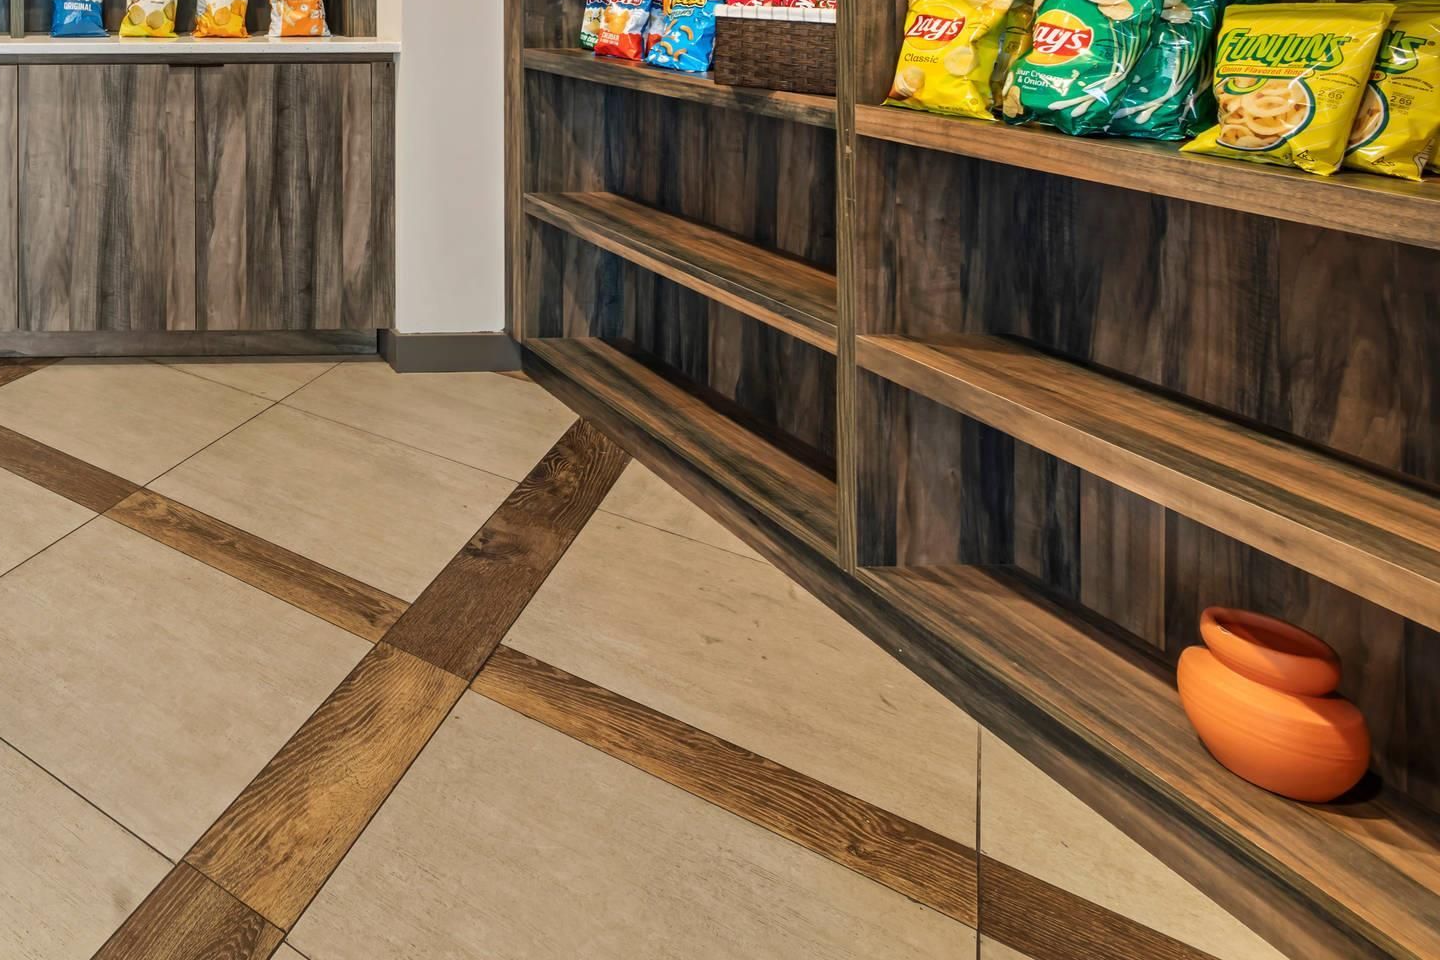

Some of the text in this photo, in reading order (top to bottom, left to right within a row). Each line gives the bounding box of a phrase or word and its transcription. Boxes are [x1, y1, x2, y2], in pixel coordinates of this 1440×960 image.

[63, 1, 93, 12] ORIGINAL
[907, 15, 963, 41] Lay's
[904, 53, 939, 64] Classic
[1024, 77, 1051, 87] Onion
